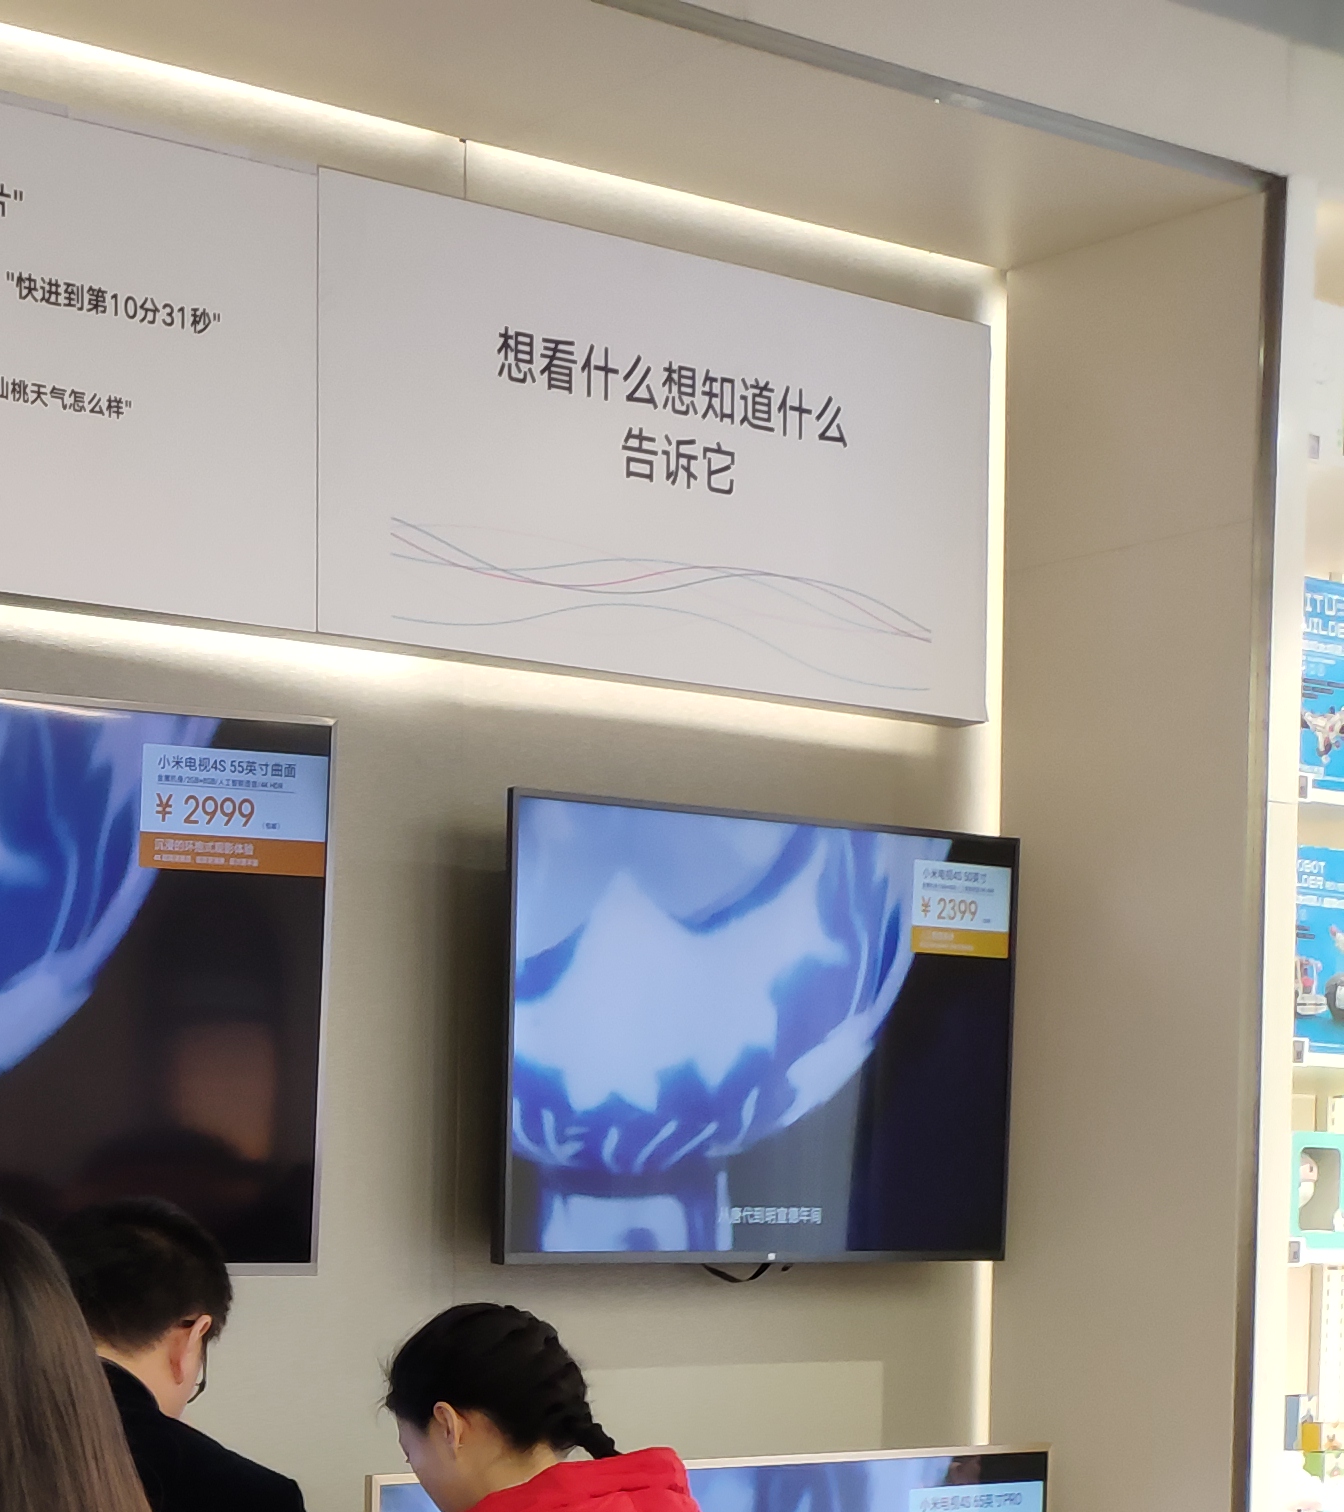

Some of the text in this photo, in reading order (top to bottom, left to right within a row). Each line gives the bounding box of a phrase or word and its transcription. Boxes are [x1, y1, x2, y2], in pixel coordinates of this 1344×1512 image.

[6, 271, 221, 335] "快进到第10分31秒"
[497, 326, 849, 448] 想看什么想知道什么
[621, 426, 737, 496] 告诉它
[183, 795, 255, 828] 2999
[937, 898, 978, 922] 2399
